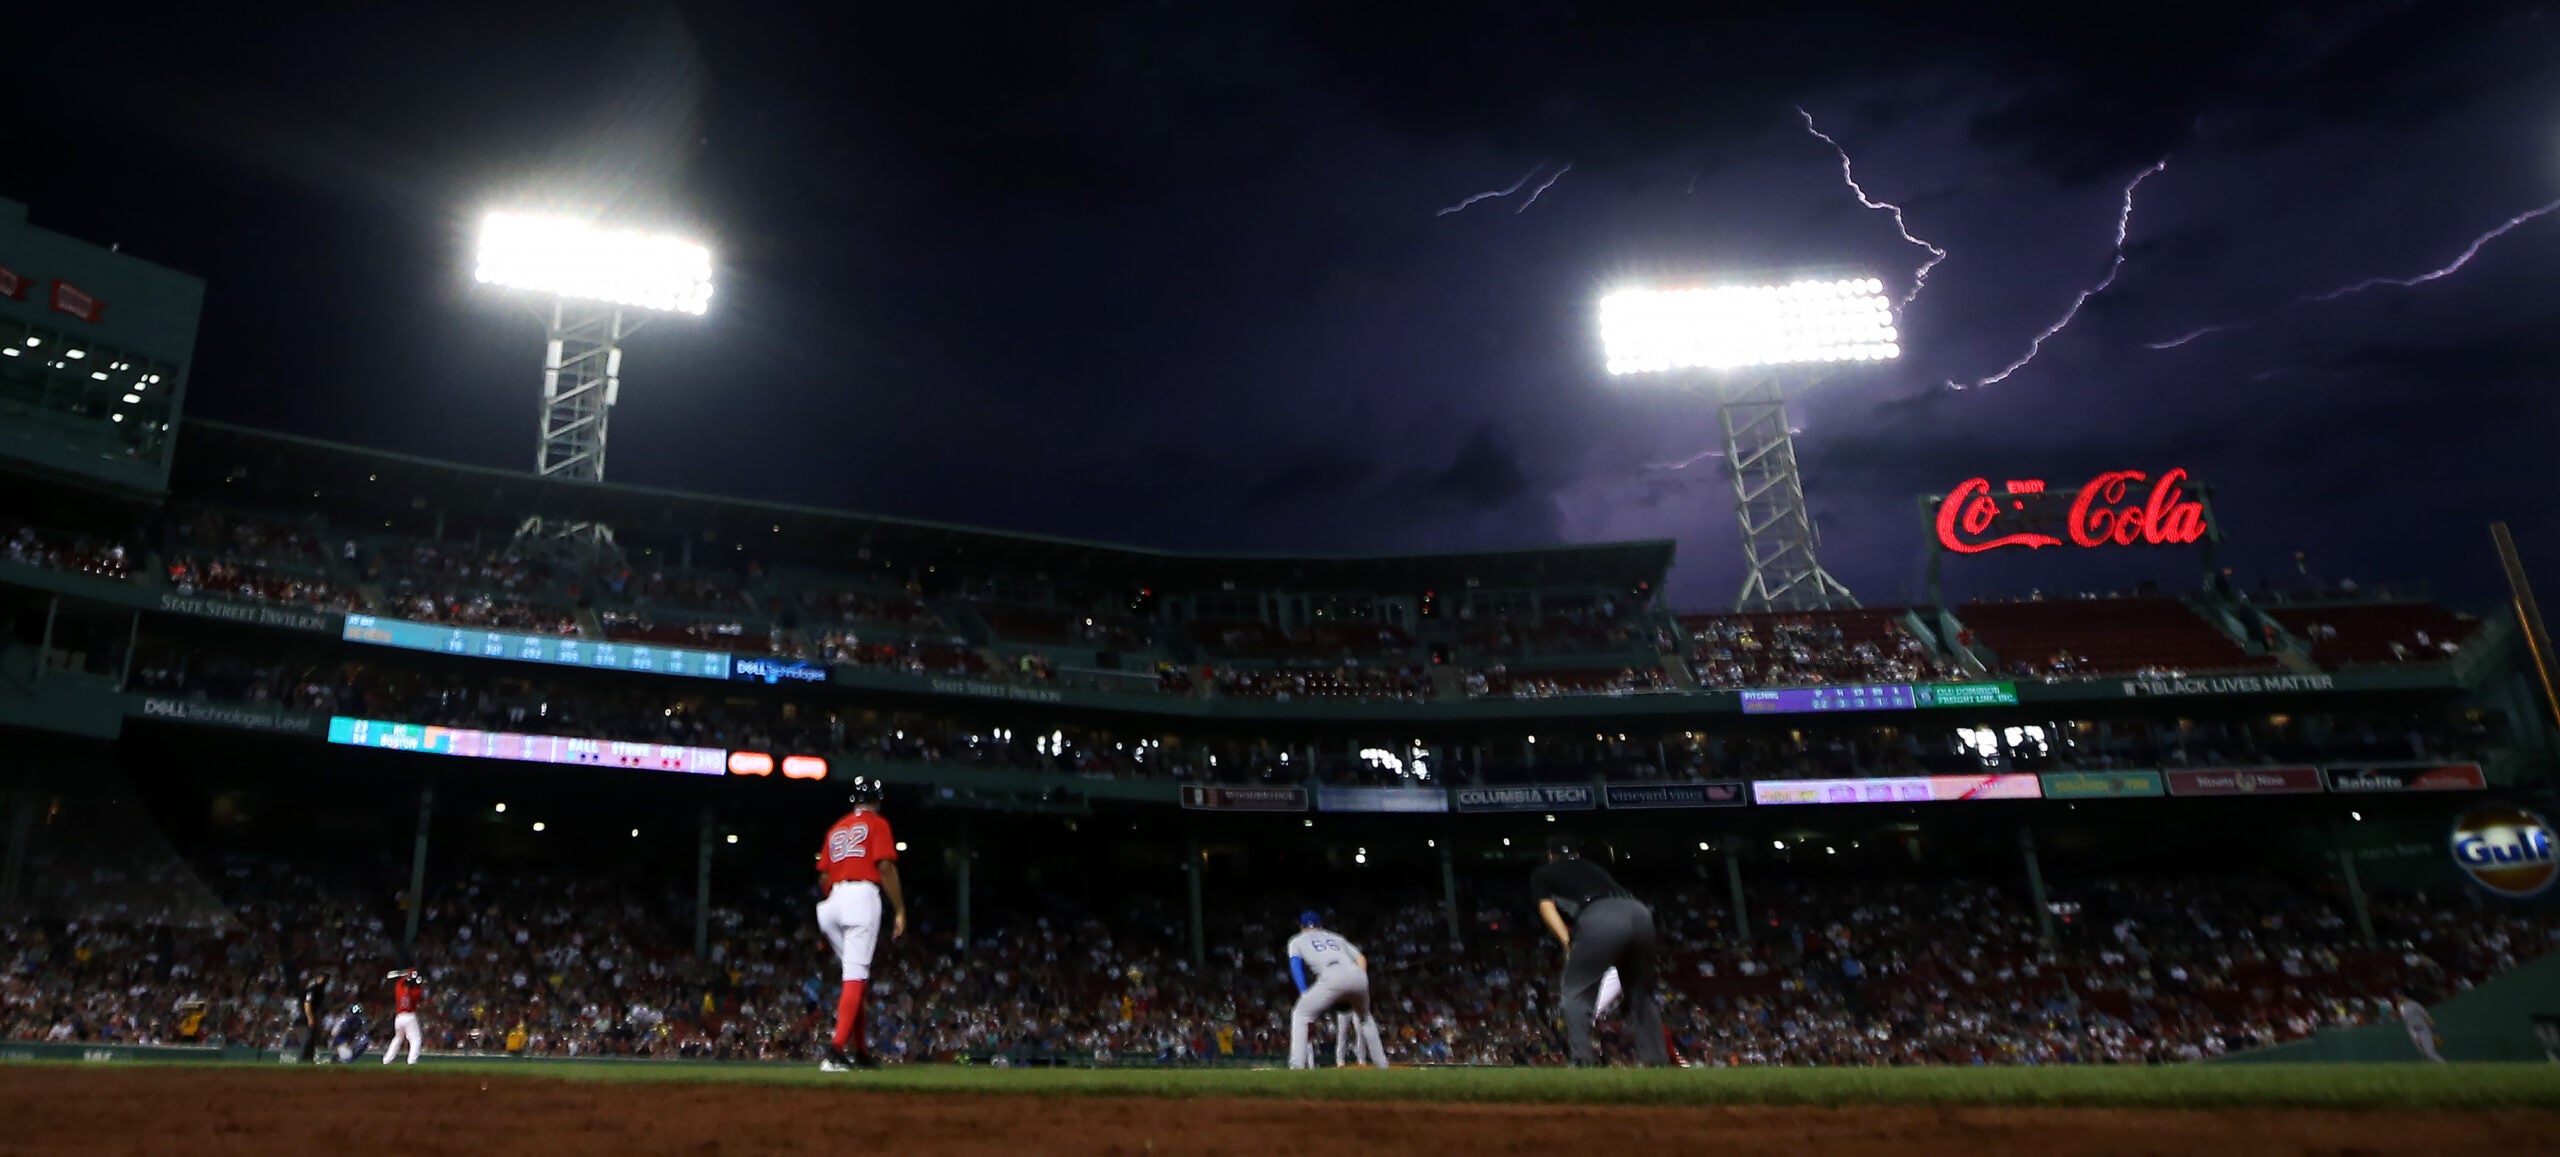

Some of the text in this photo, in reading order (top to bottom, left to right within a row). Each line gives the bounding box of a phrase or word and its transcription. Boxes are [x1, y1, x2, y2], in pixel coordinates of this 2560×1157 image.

[2009, 481, 2044, 493] ENJOY
[160, 595, 327, 631] STATE STREET PAVILION
[1937, 687, 1954, 696] OLD
[1956, 685, 2000, 696] DOMINION
[2152, 674, 2334, 696] BLACK LIVES MATTER
[1938, 695, 1974, 704] FREIGHT
[144, 697, 310, 732] DELL Technologies Level
[2337, 774, 2403, 789] Safelite
[1460, 788, 1587, 805] COLUMBIA TECH
[829, 822, 869, 863] 82
[2457, 830, 2553, 864] Gulf
